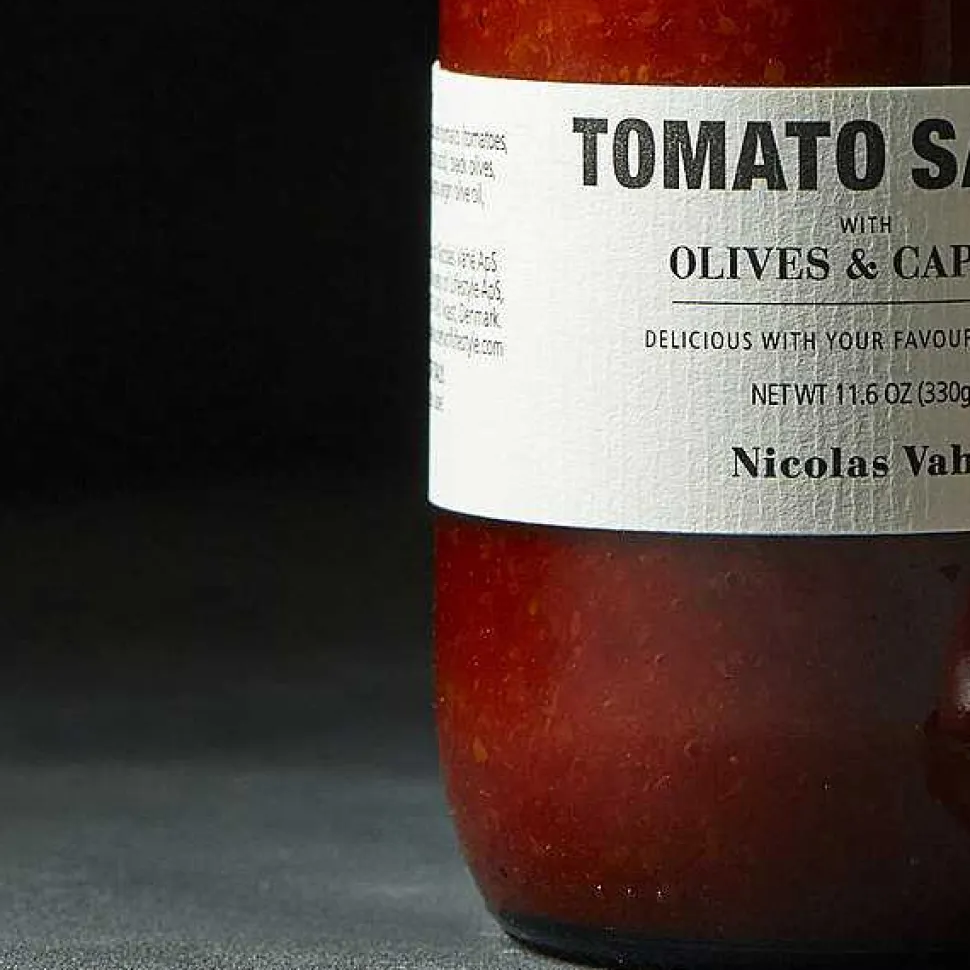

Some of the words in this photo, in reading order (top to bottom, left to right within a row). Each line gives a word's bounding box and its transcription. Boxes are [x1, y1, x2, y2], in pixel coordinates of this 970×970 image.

[573, 116, 885, 191] TOMATO
[840, 216, 891, 234] WITH
[669, 245, 830, 280] OLIVES
[847, 248, 879, 280] &
[644, 329, 753, 351] DELICIOUS
[761, 330, 817, 351] WITH
[827, 330, 885, 351] YOUR
[751, 382, 791, 406] NET
[794, 383, 828, 406] WT
[836, 382, 879, 406] 11.6
[884, 382, 913, 404] OZ
[731, 446, 889, 478] Nicolas
